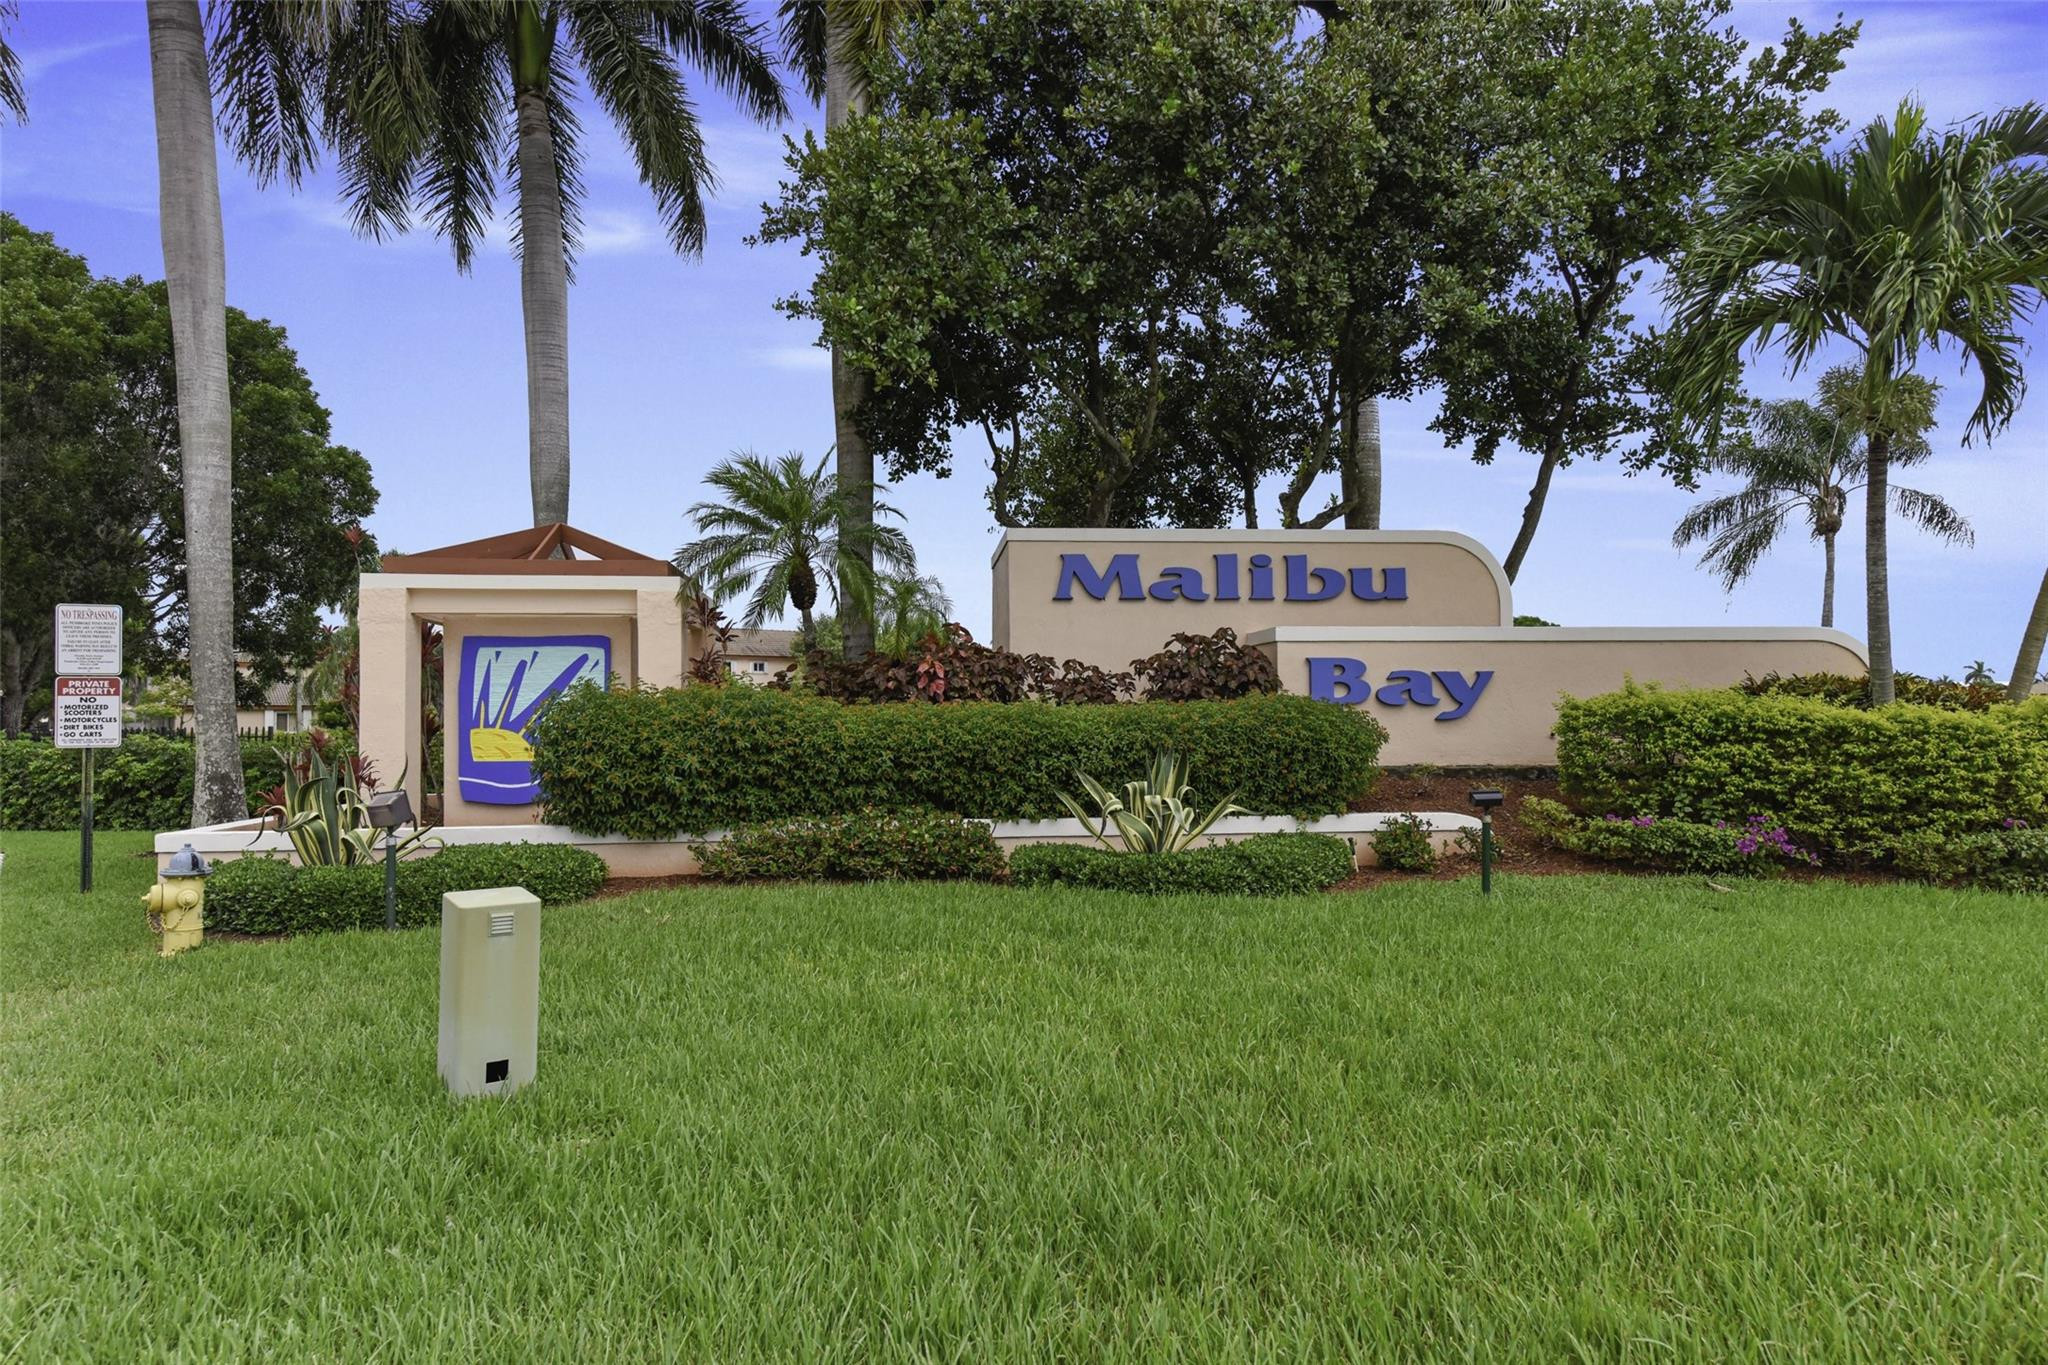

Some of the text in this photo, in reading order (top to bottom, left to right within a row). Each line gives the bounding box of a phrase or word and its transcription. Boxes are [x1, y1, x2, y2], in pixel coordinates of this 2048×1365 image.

[1052, 553, 1410, 602] Malibu
[61, 610, 118, 620] NO TRESPASSING
[1305, 656, 1495, 721] Bay
